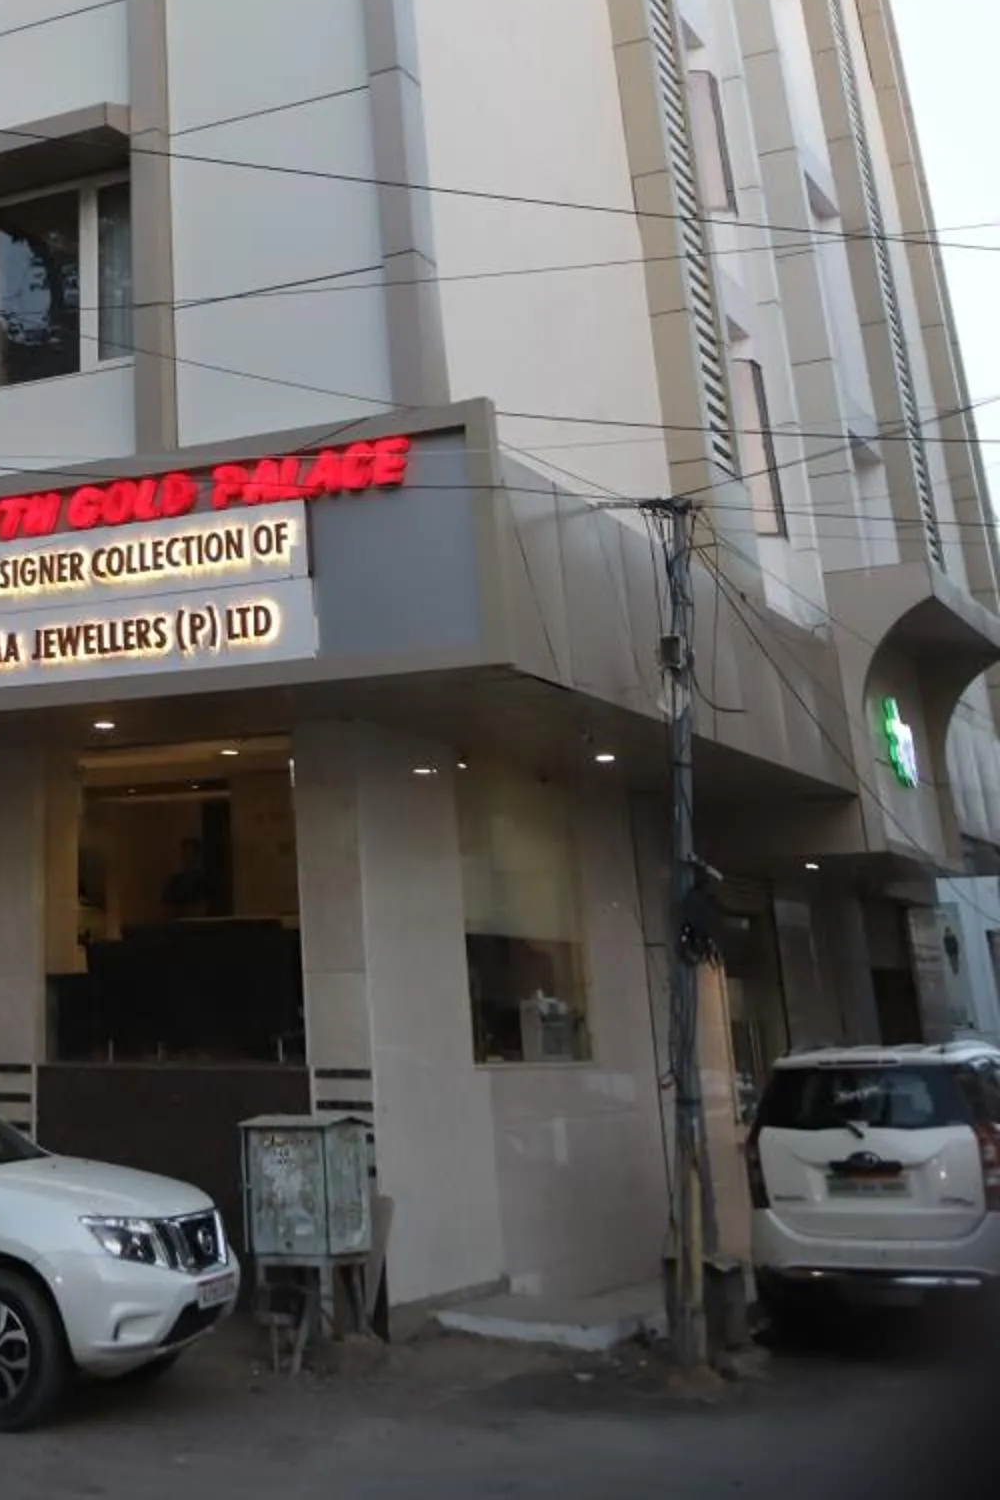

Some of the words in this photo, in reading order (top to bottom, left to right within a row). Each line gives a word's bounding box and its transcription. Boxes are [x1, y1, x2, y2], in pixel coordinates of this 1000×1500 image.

[66, 470, 197, 531] GOLD
[210, 435, 409, 511] PALACE
[90, 527, 244, 581] COLLECTION
[252, 521, 289, 556] OF
[31, 616, 168, 661] JEWELLERS
[175, 604, 217, 651] (P)
[225, 605, 273, 641] LTD
